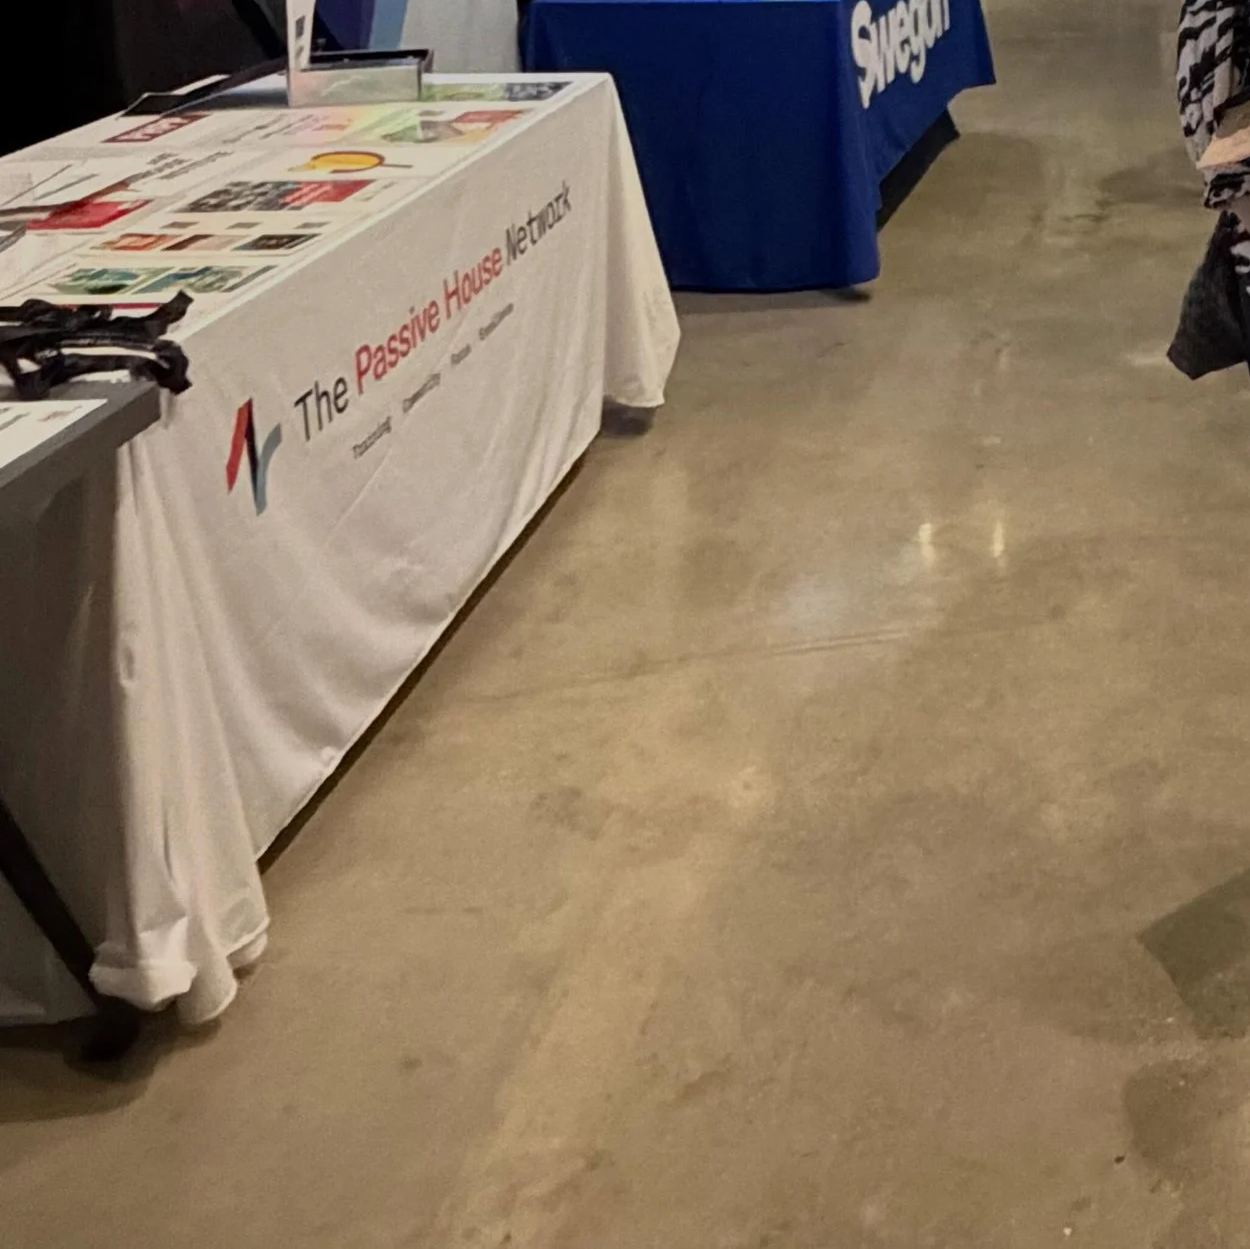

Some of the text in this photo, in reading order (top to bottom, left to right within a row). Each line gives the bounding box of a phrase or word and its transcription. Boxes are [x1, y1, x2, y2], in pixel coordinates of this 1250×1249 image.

[294, 376, 349, 442] The
[355, 299, 441, 396] Passive
[443, 246, 503, 321] House
[505, 179, 573, 267] Network
